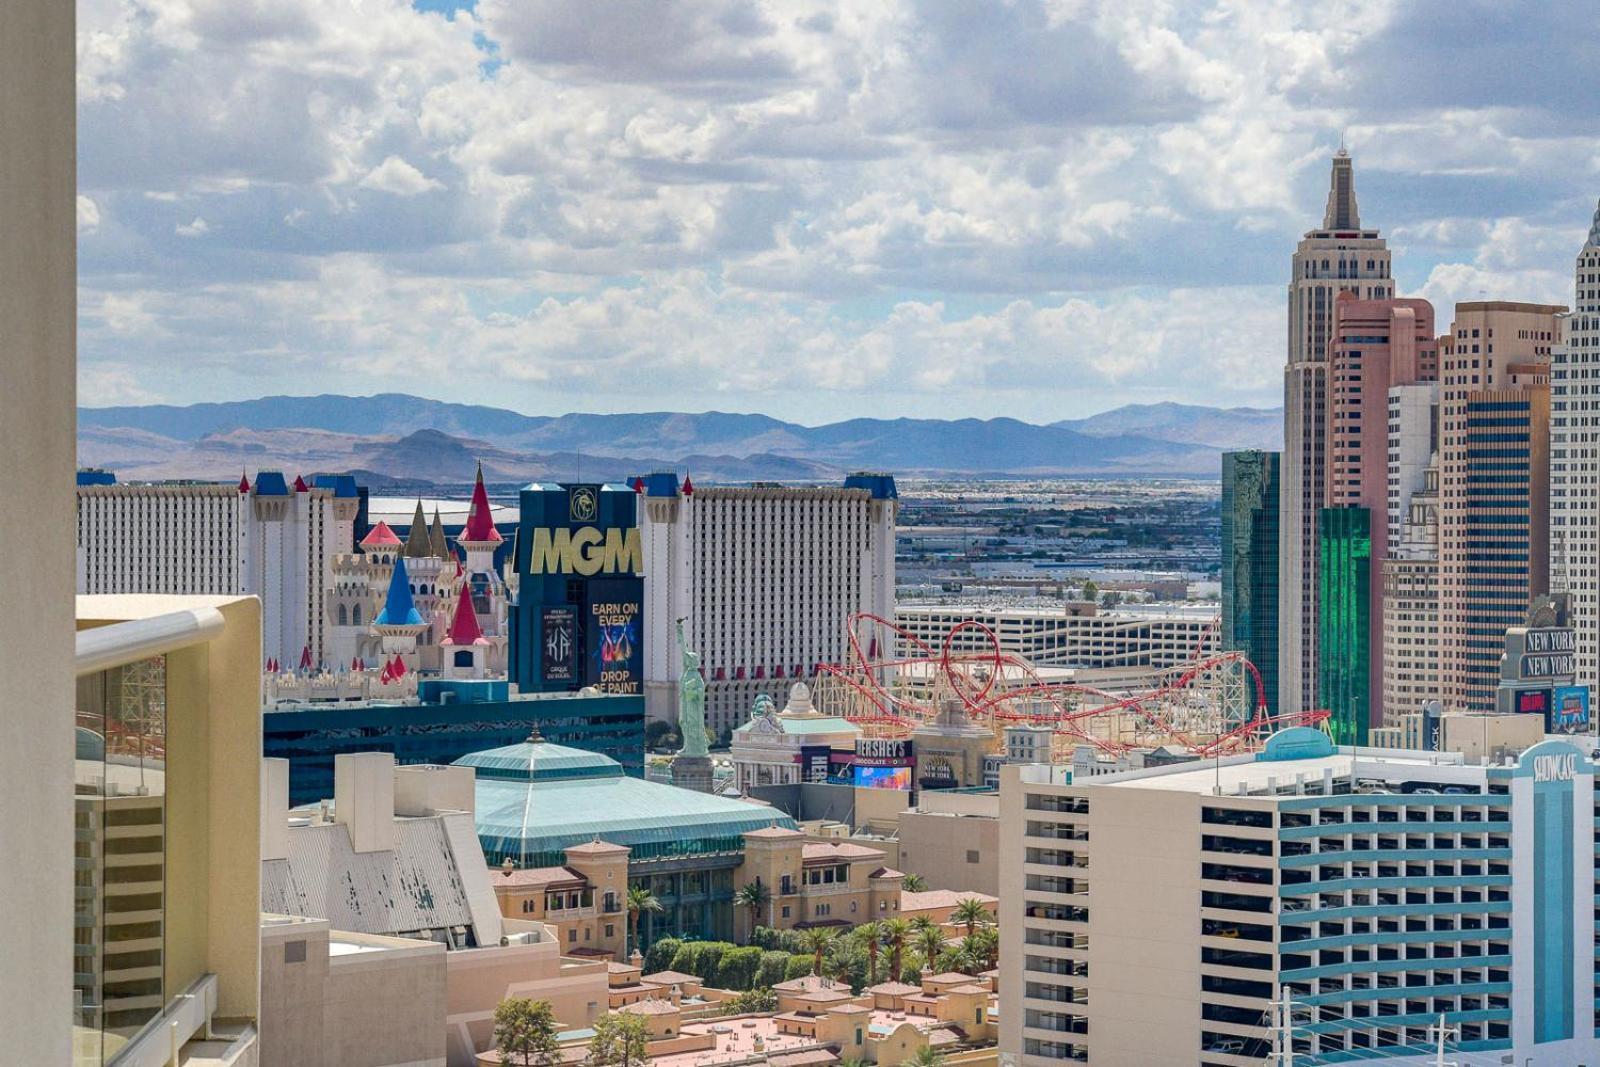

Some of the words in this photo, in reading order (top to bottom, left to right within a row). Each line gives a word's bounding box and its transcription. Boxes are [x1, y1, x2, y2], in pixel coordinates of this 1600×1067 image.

[530, 526, 644, 576] MGM
[592, 603, 620, 615] EARN
[622, 603, 638, 614] ON
[599, 615, 631, 626] EVERY
[1528, 632, 1548, 651] NEW
[1550, 631, 1575, 650] YORK
[1528, 656, 1548, 676] NEW
[1550, 655, 1574, 675] YORK
[601, 671, 630, 682] DROP
[608, 682, 638, 695] PAINT
[1534, 753, 1577, 782] SHOWCASE
